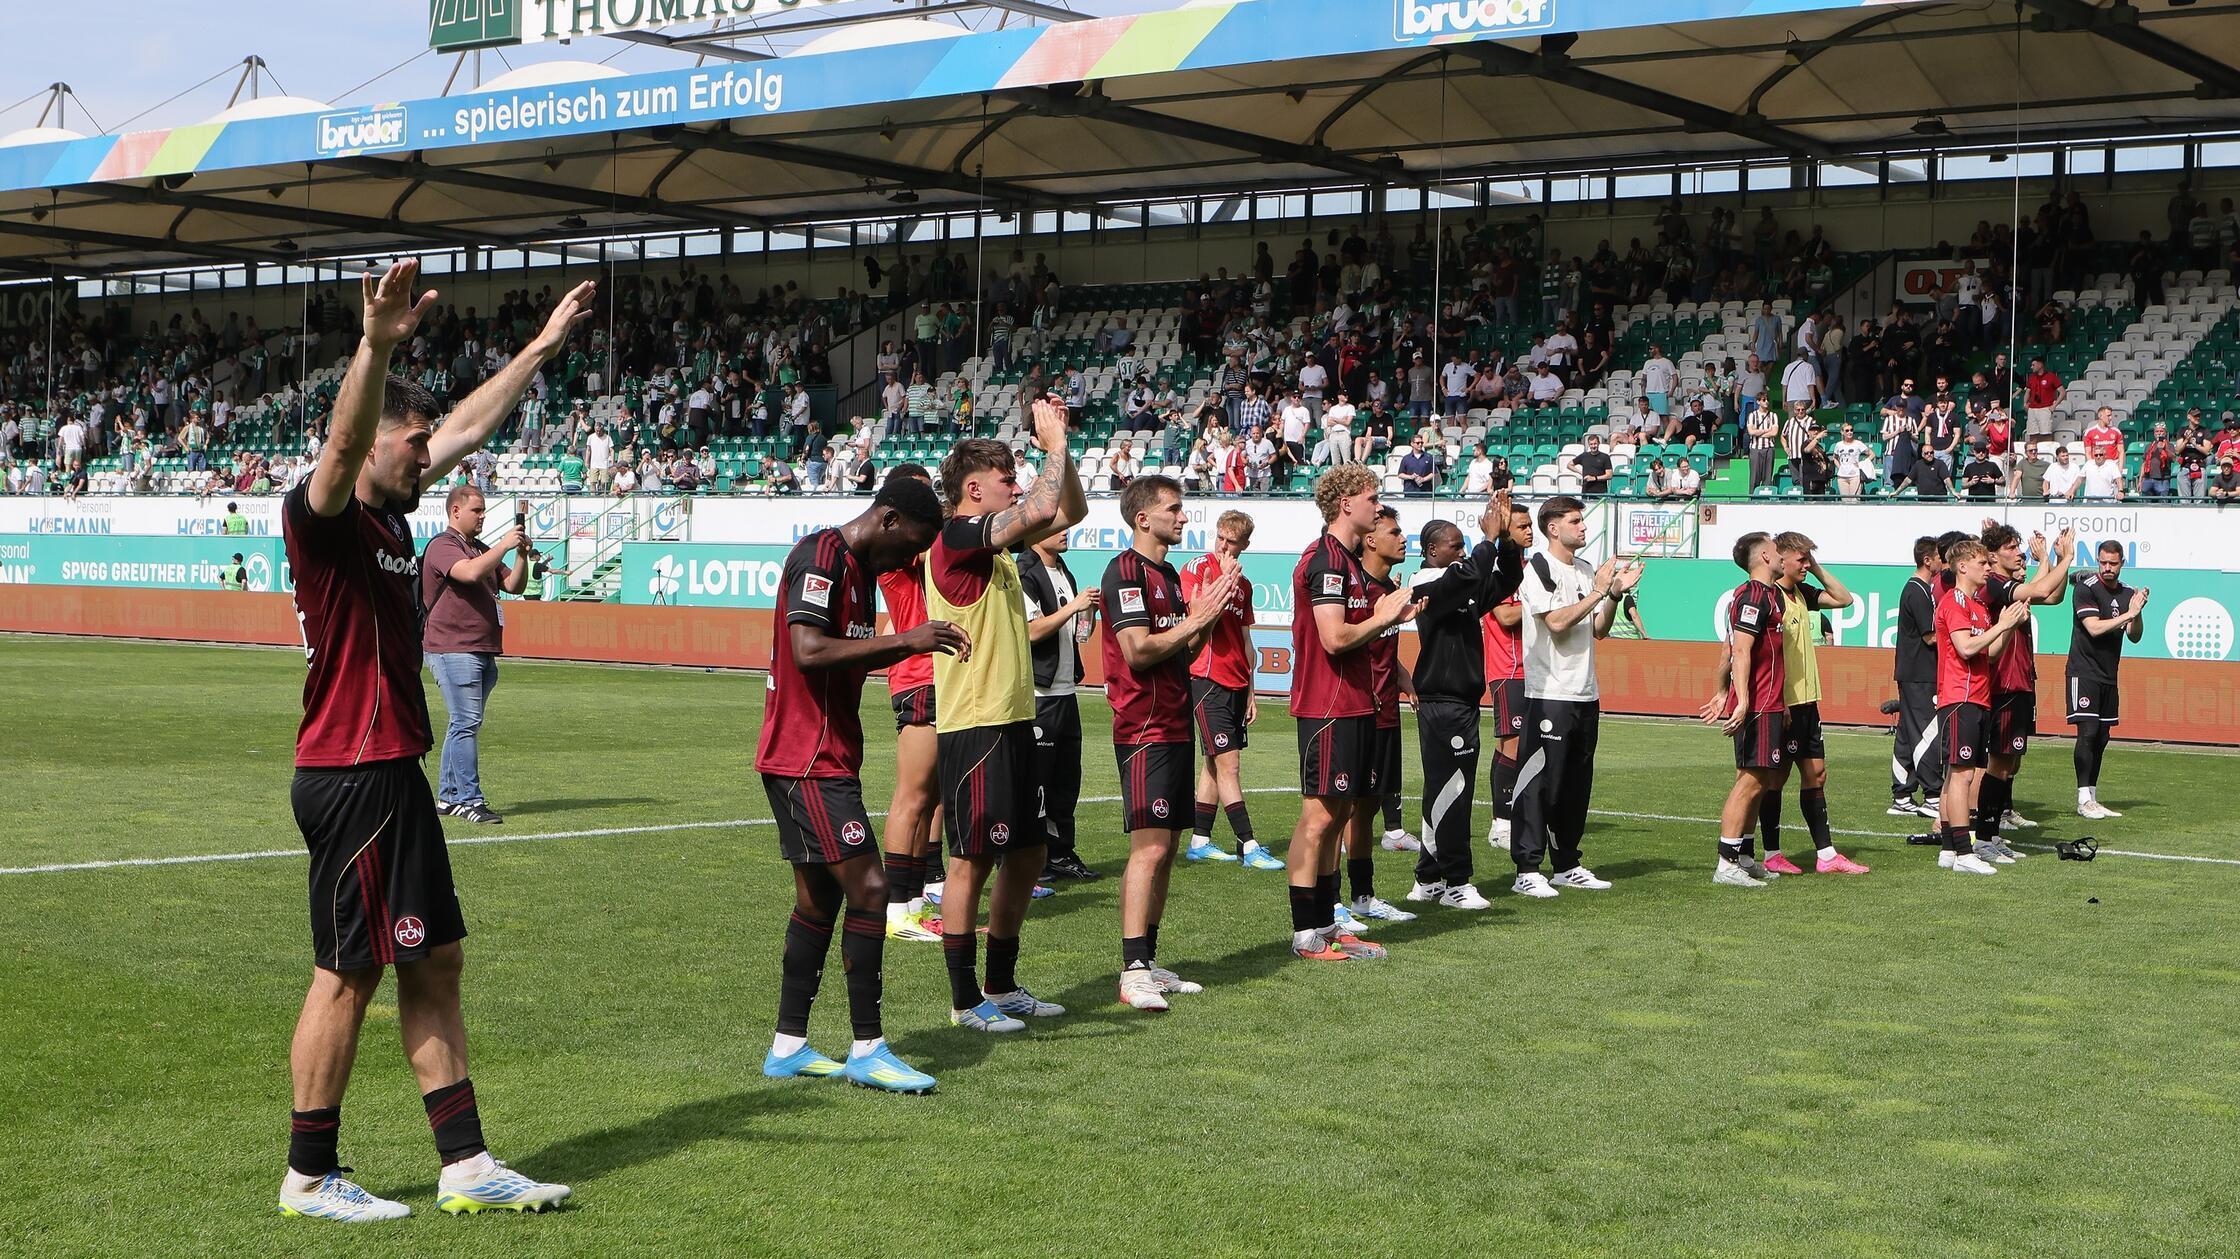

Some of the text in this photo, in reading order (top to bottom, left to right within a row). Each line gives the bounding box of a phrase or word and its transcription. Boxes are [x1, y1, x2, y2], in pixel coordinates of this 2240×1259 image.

[455, 89, 606, 142] spielerisch
[616, 86, 677, 118] zum
[689, 68, 783, 112] Erfolg
[0, 288, 73, 327] LOCK
[76, 500, 111, 513] Personal
[236, 501, 269, 514] ersonal
[1704, 508, 1712, 521] 9
[2044, 512, 2138, 533] Personal
[62, 561, 107, 580] SPVGG
[111, 562, 185, 583] GREUTHER
[520, 613, 560, 647] Mit
[625, 619, 682, 652] wird
[845, 829, 864, 841] FCN
[992, 831, 1008, 840] FCN
[399, 927, 423, 941] FCN
